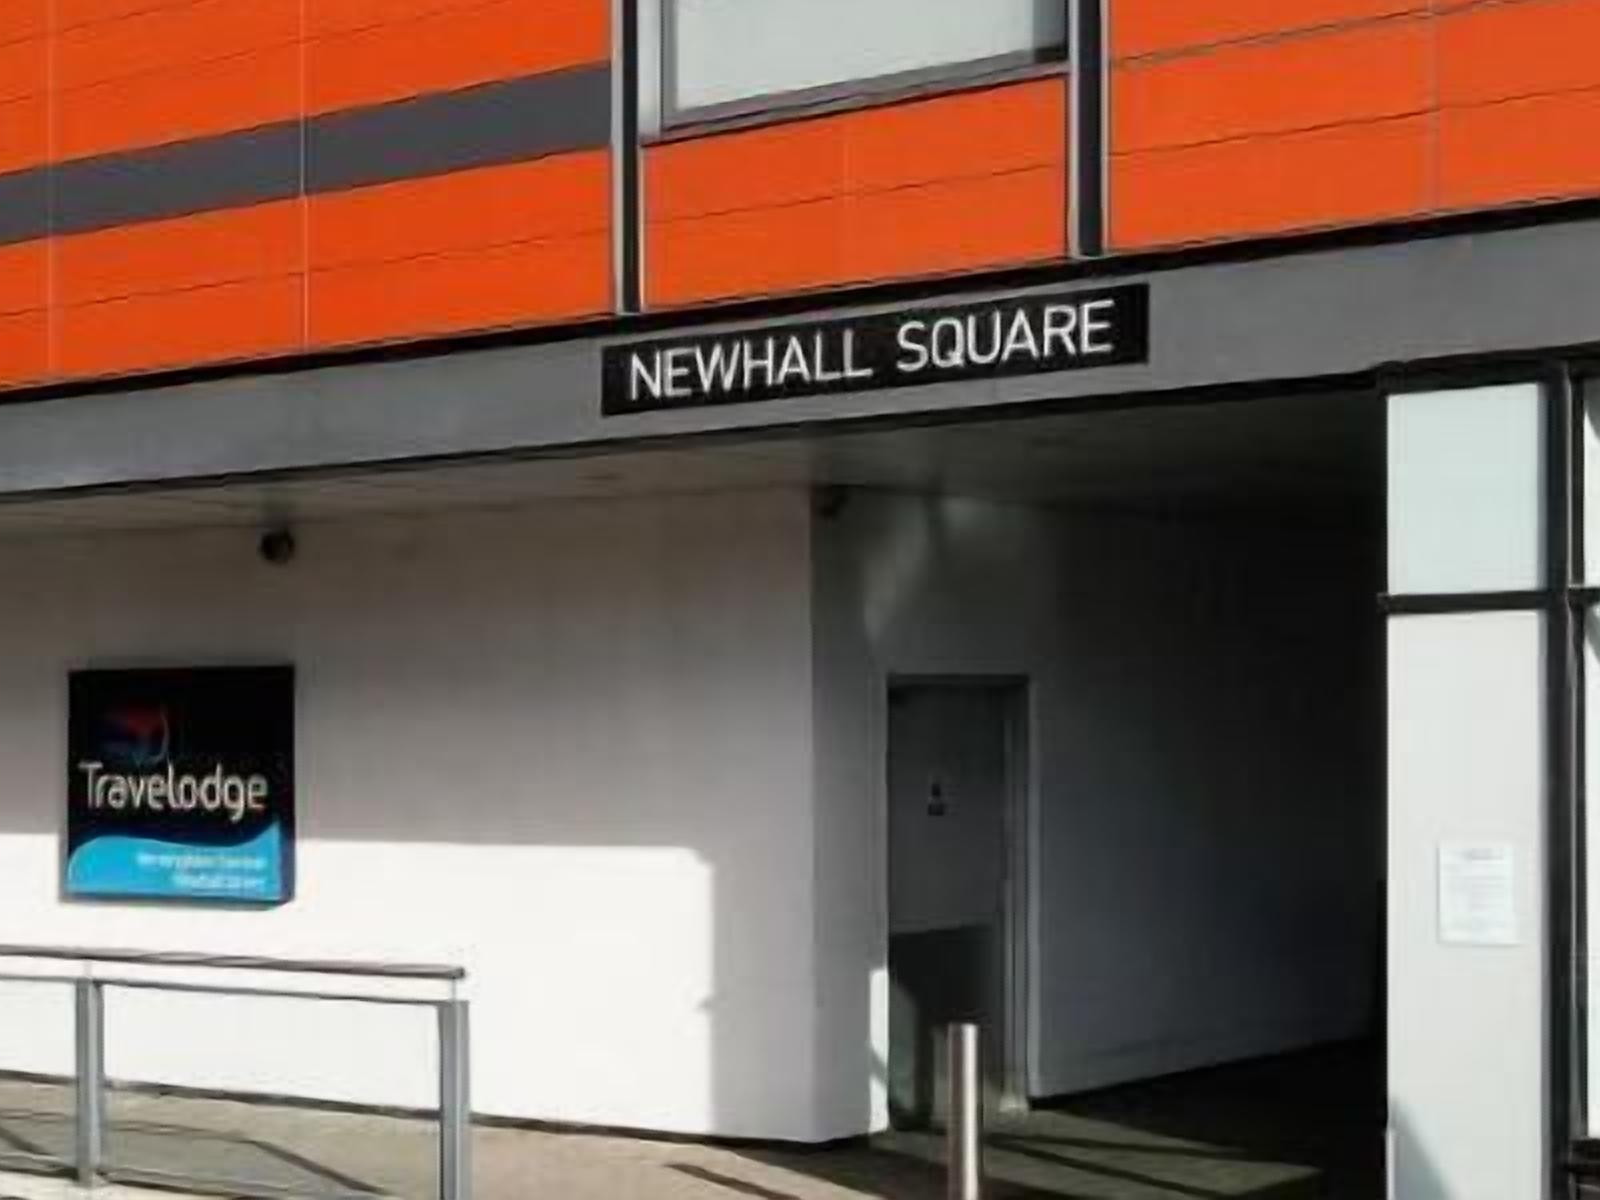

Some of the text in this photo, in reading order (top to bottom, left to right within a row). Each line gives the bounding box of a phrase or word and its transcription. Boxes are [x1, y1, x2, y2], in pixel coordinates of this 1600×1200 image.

[628, 300, 1116, 402] NEWHALL SQUARE
[78, 759, 269, 823] Travelodge
